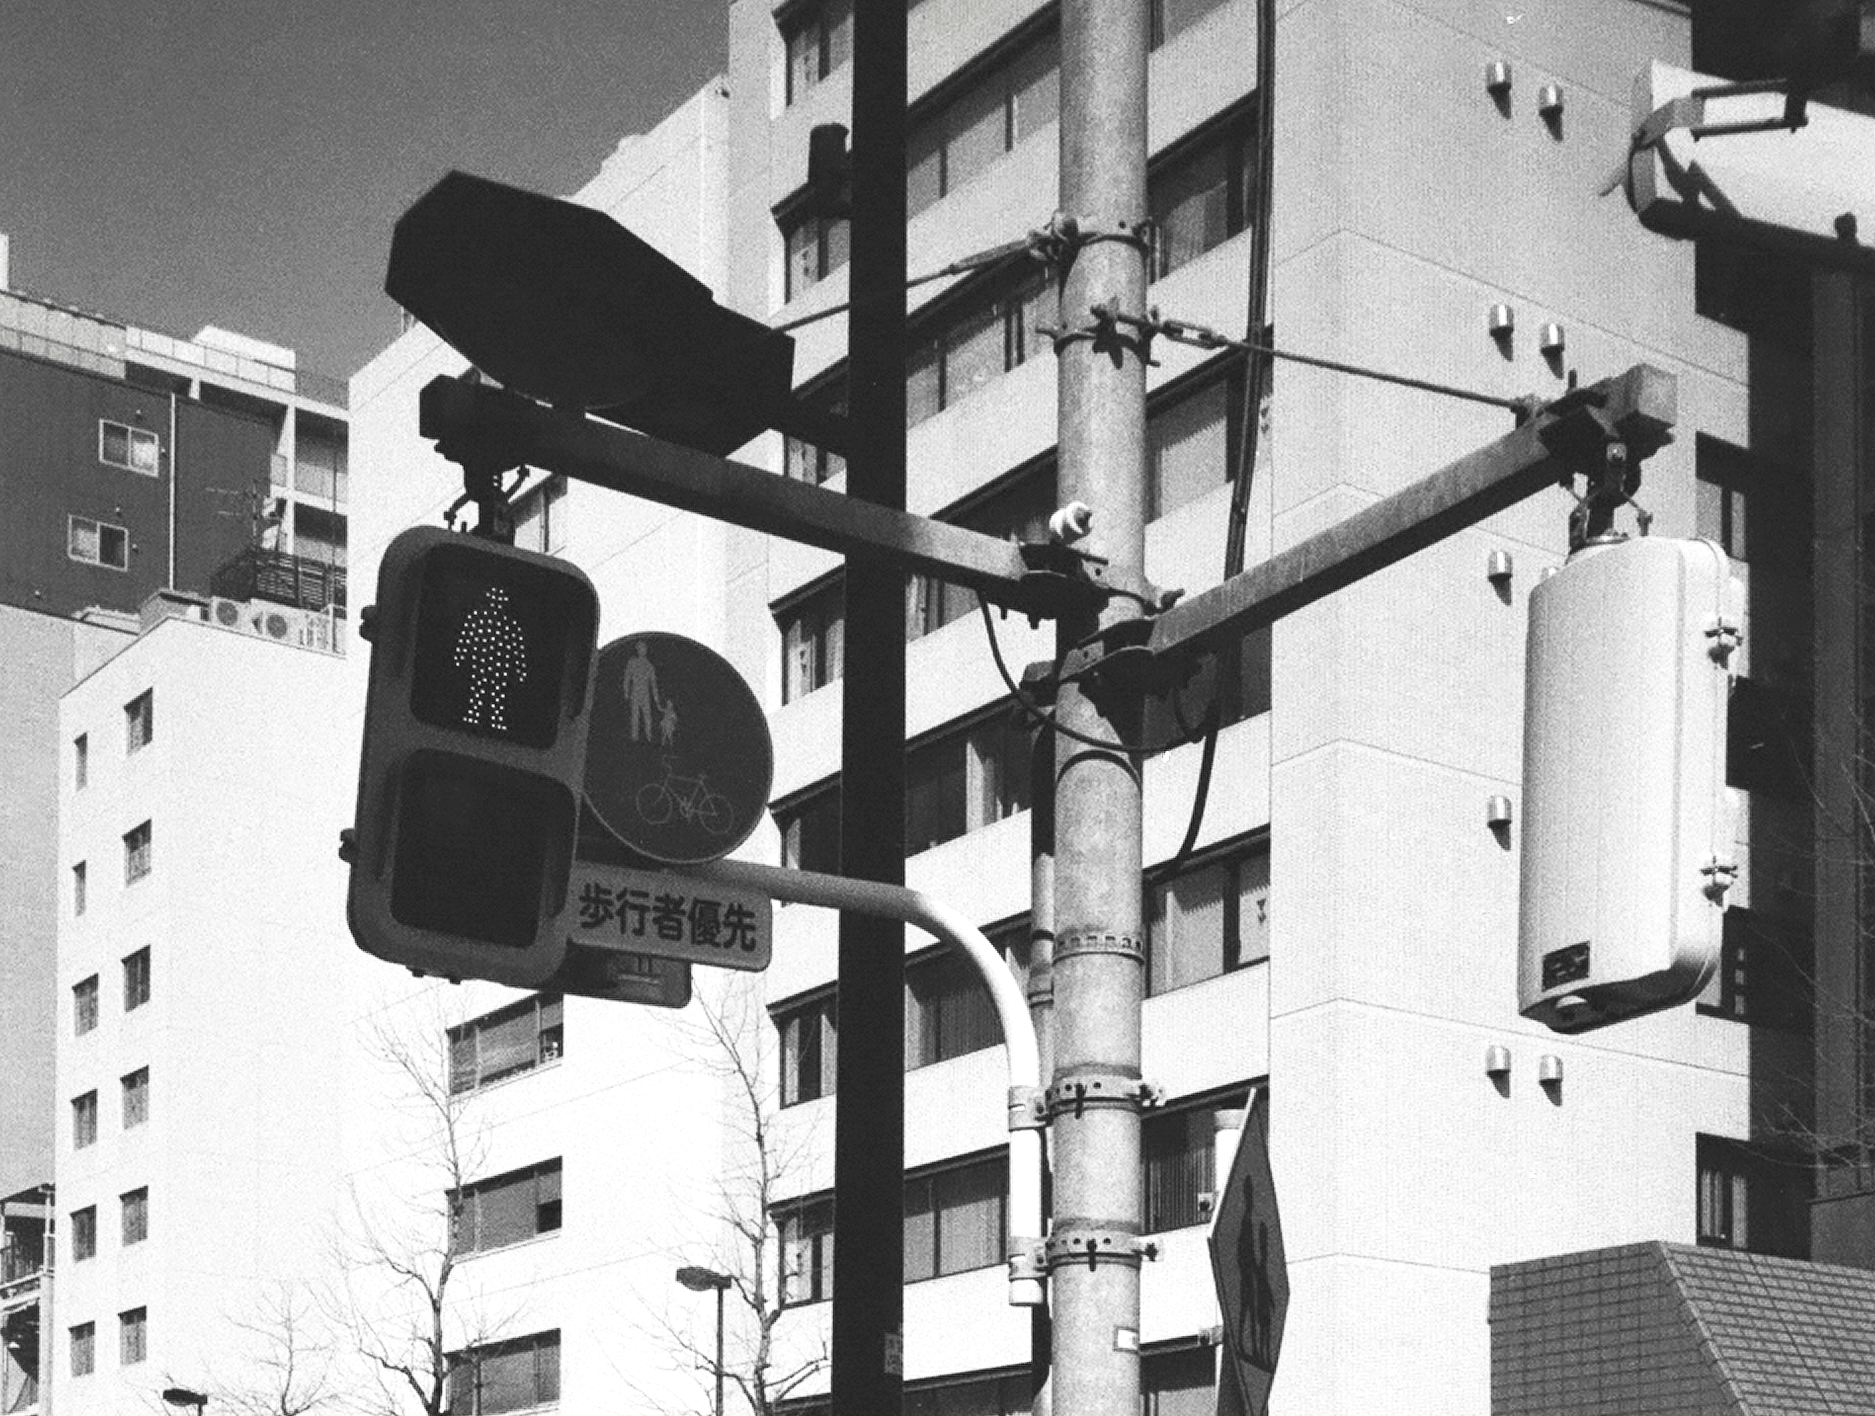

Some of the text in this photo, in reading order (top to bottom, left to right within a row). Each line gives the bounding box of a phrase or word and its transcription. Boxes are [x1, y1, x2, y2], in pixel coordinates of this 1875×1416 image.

[578, 882, 757, 951] 歩行者優先
